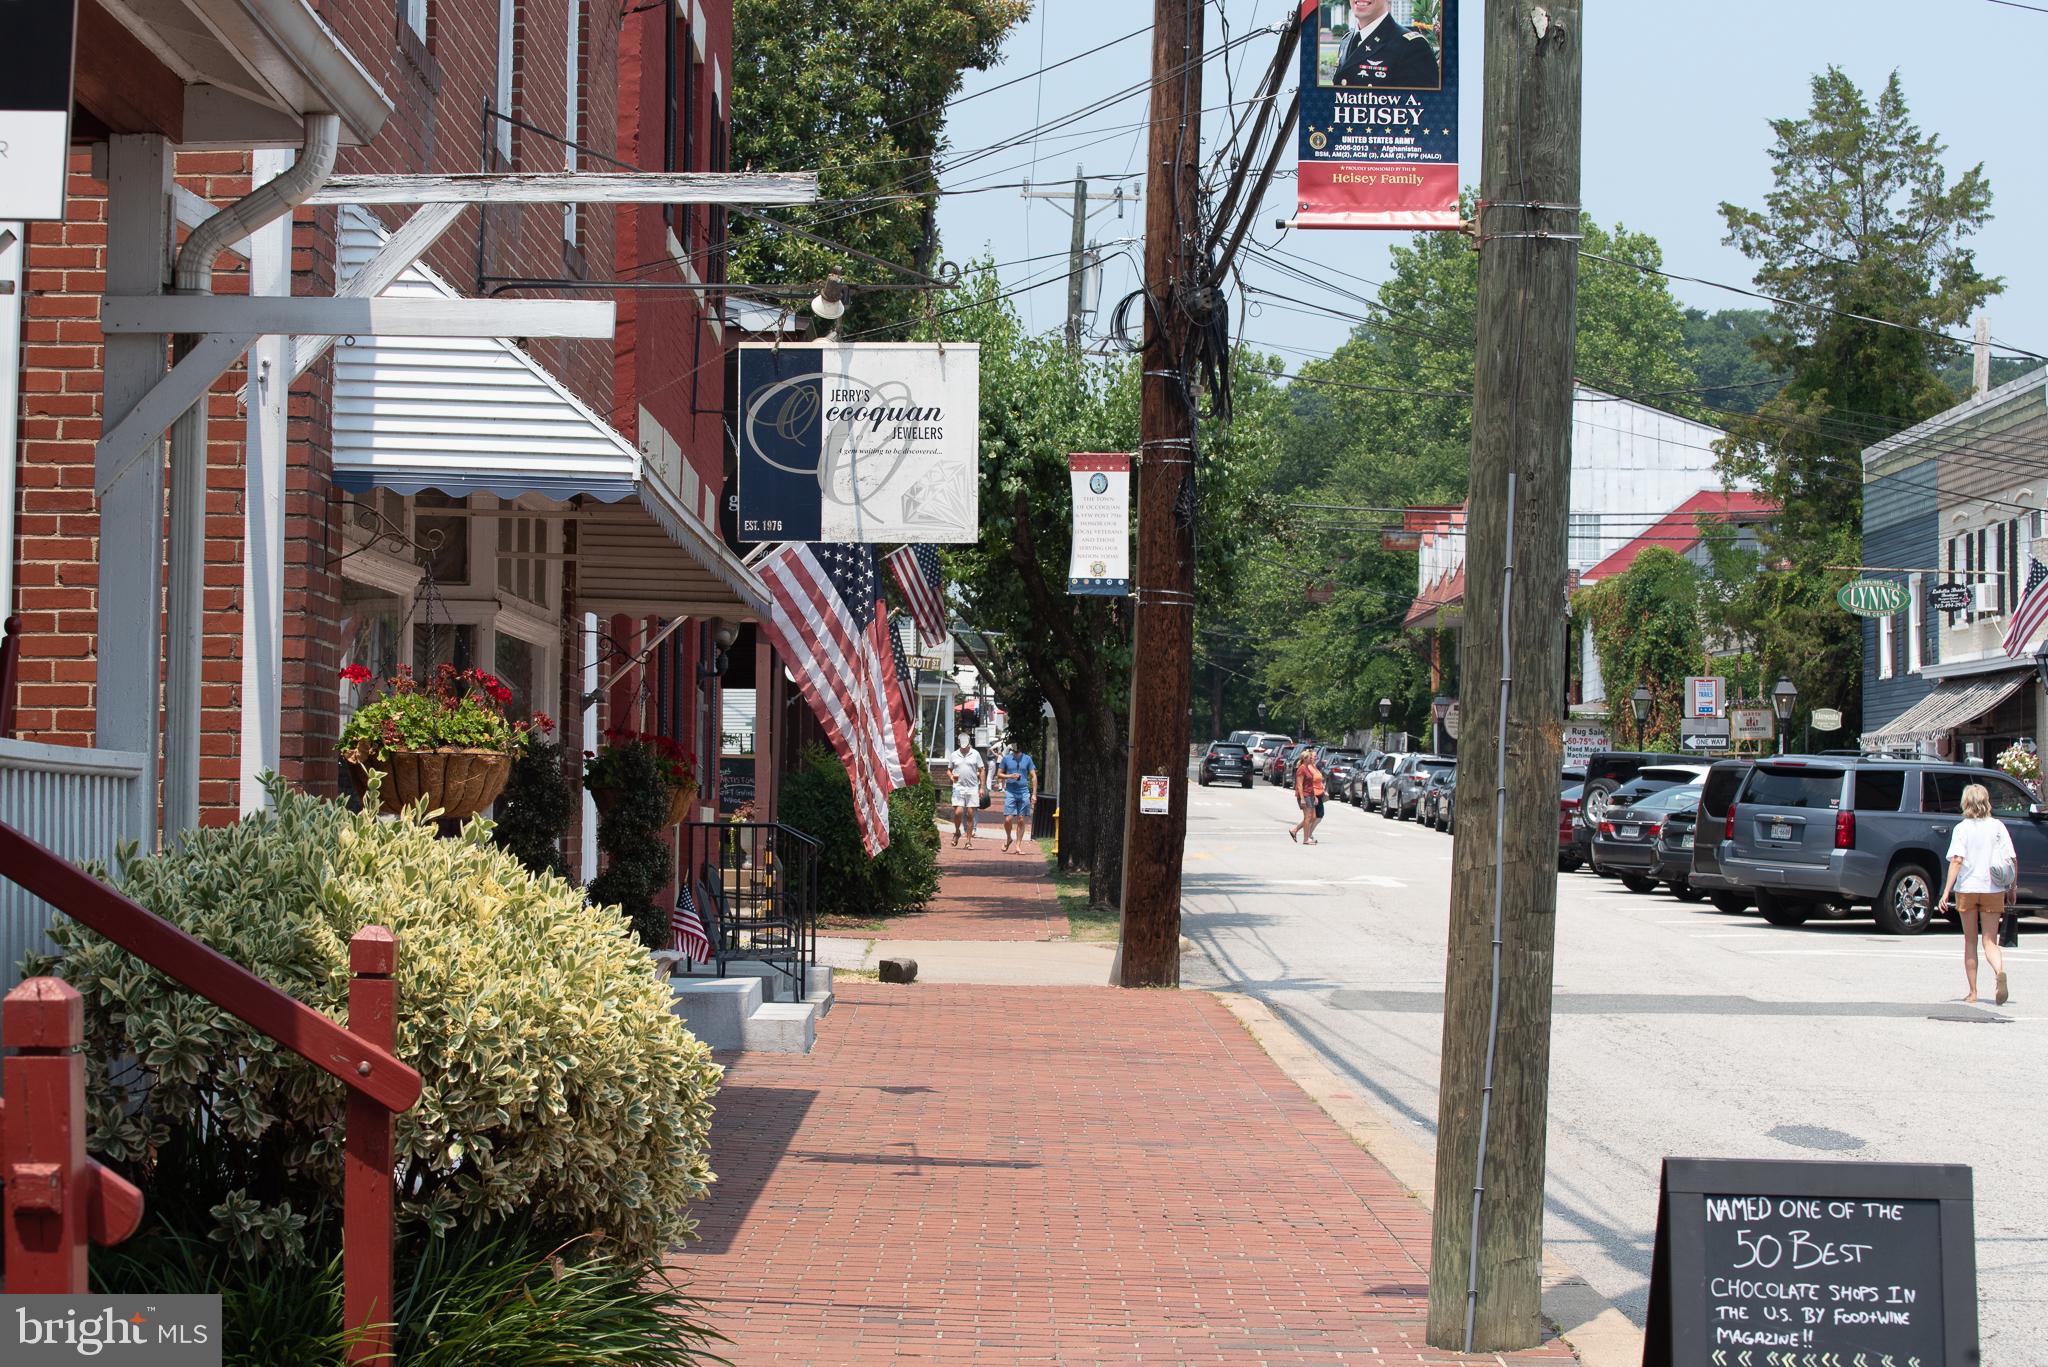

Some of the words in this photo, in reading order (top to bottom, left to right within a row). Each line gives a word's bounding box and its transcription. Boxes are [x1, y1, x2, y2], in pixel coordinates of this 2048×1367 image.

[1335, 92, 1401, 105] Matthew
[1405, 94, 1421, 106] A.
[1334, 107, 1424, 125] HEISEY
[1342, 136, 1367, 144] UNITED
[1368, 136, 1394, 144] STATES
[1395, 137, 1415, 145] ARMY
[1381, 145, 1422, 153] Afghanistan
[1332, 173, 1377, 186] Heisey
[1381, 174, 1424, 186] Family
[830, 389, 870, 402] JERRY'S
[892, 426, 943, 440] JEWELERS
[859, 448, 884, 456] waiting
[744, 520, 760, 531] EST.
[762, 520, 783, 531] 1976
[1853, 609, 1870, 617] RIVER
[1571, 727, 1587, 736] Rug
[1567, 737, 1595, 745] 50-75%
[1707, 1197, 1772, 1222] NAMED
[1779, 1199, 1822, 1219] ONE
[1828, 1202, 1855, 1219] OF
[1862, 1203, 1904, 1220] THE
[1733, 1229, 1782, 1268] 50
[1711, 1277, 1820, 1300] CHOCOLATE
[1828, 1285, 1879, 1303] SHOPS
[1885, 1286, 1916, 1304] IN
[1715, 1306, 1749, 1320] THE
[1763, 1306, 1793, 1322] U.S.
[1801, 1306, 1825, 1324] BY
